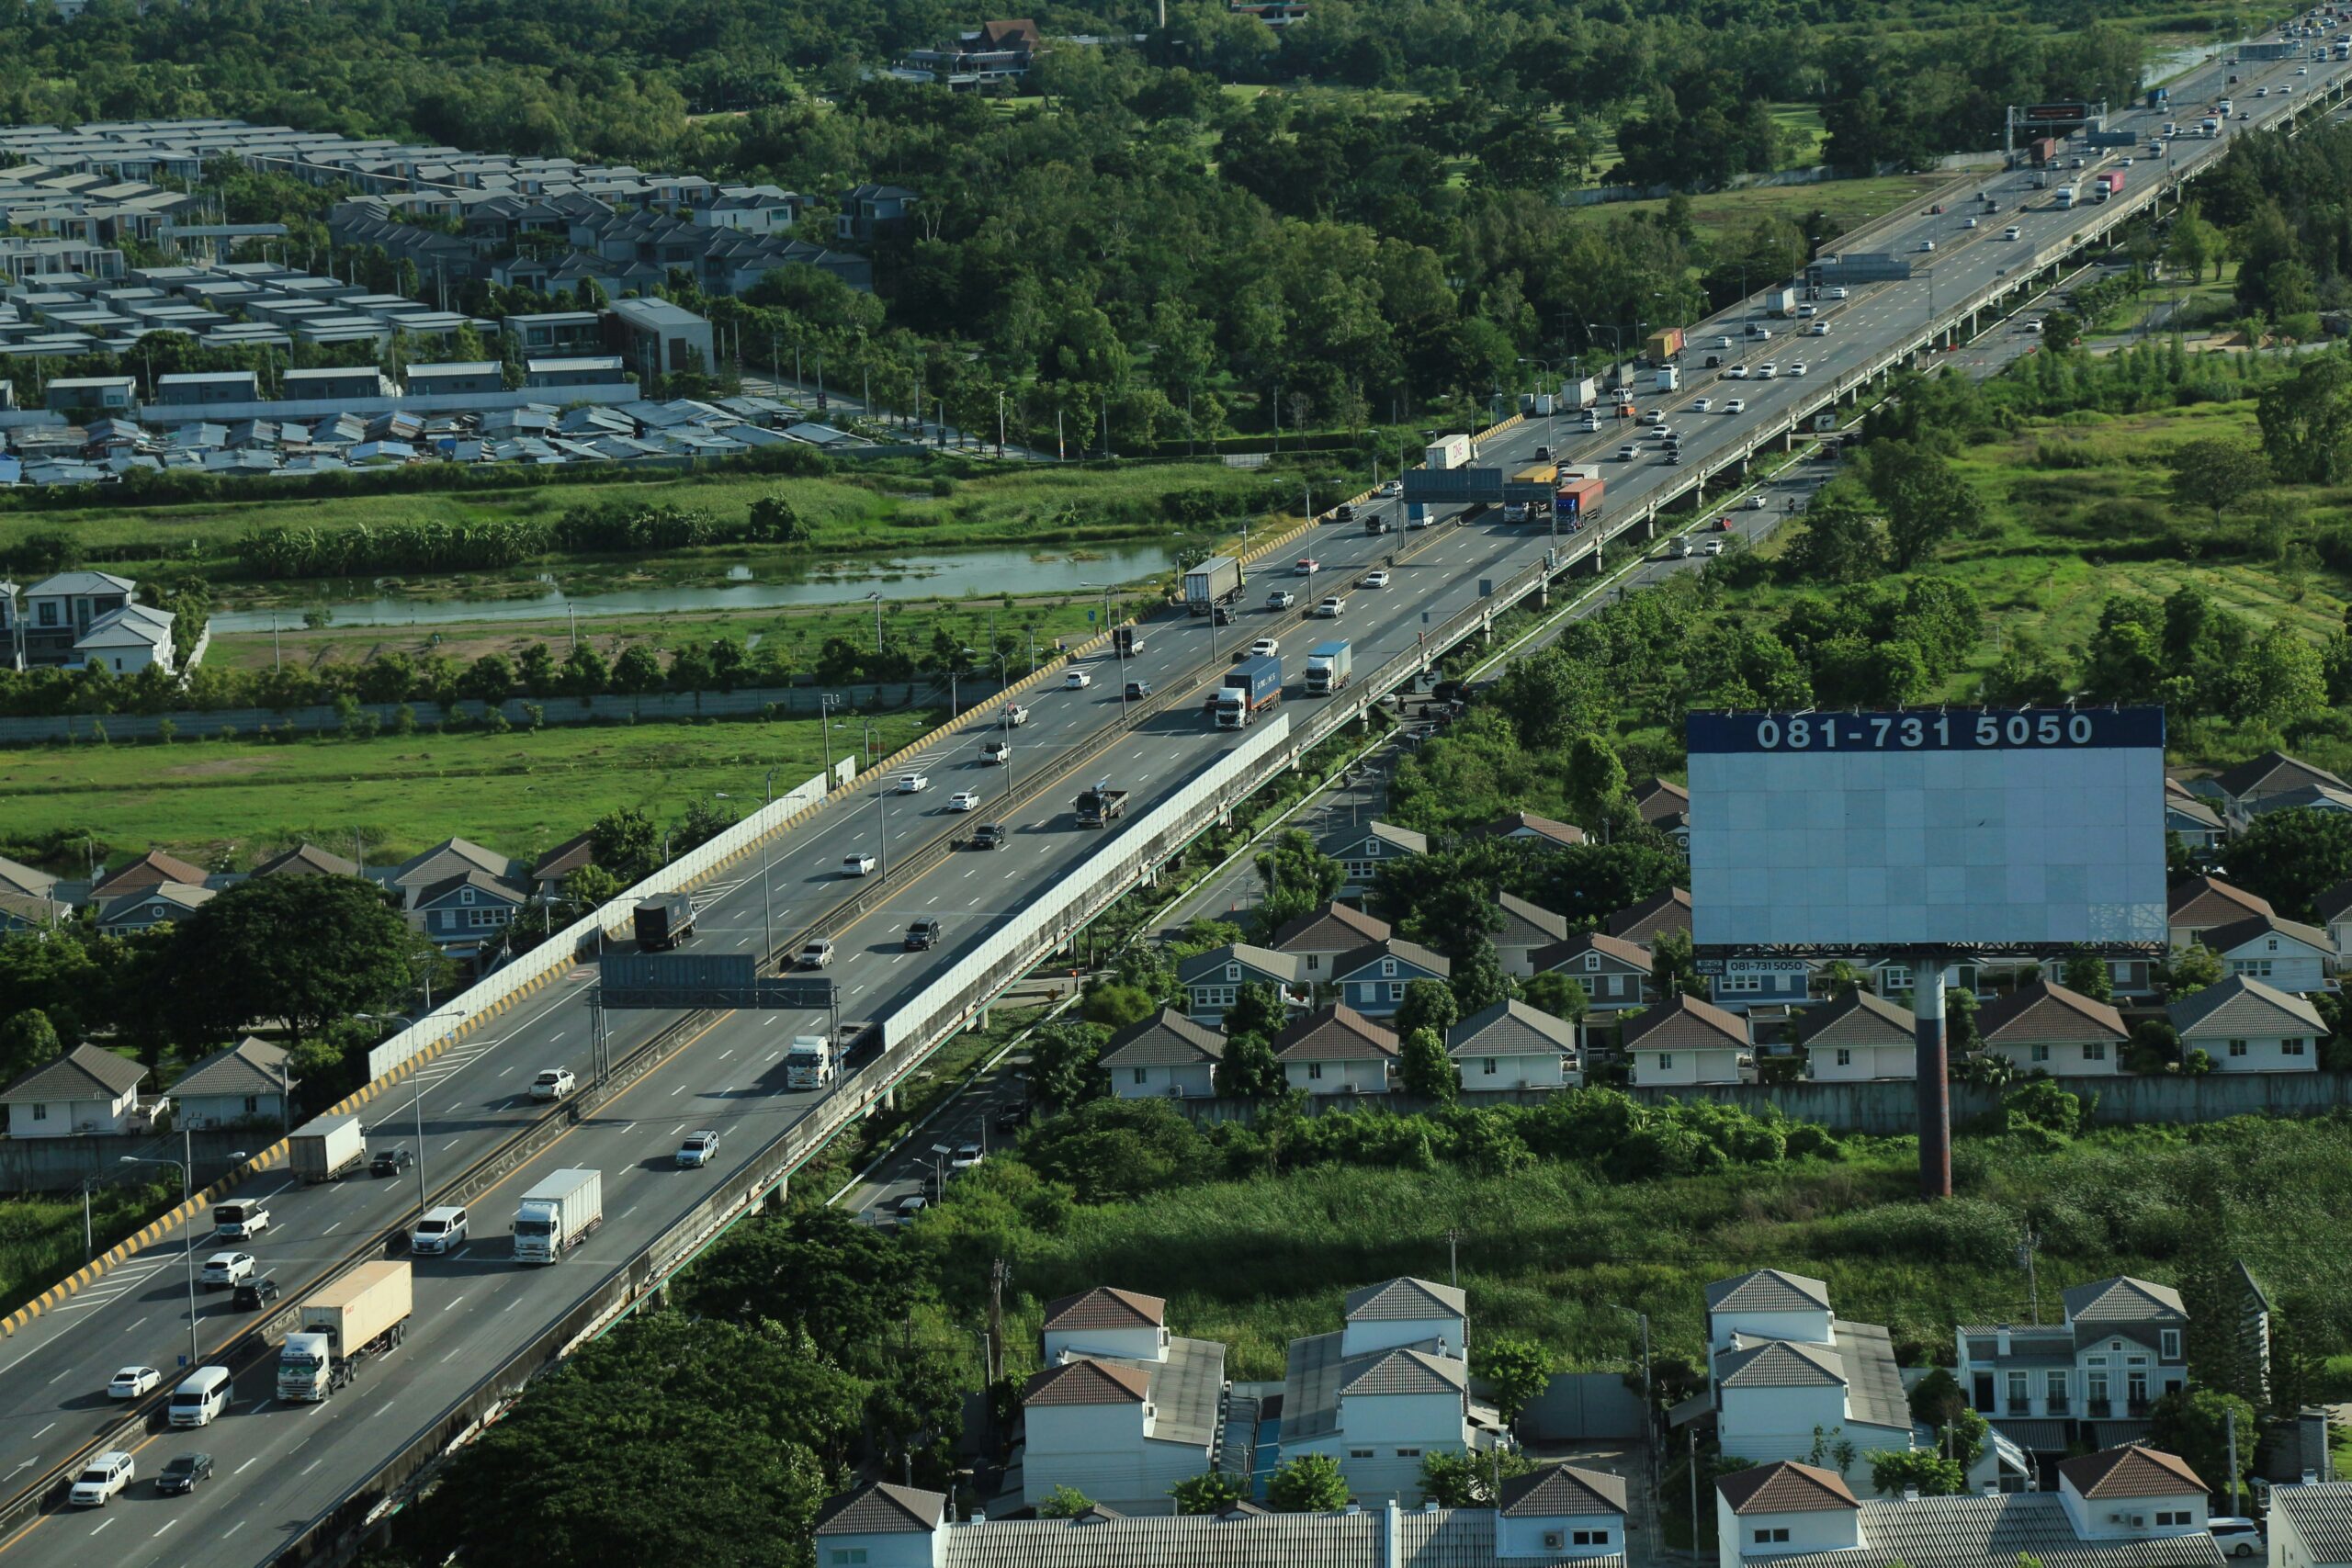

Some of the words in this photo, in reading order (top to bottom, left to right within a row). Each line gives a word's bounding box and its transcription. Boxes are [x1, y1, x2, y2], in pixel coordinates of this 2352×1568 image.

[1757, 717, 1949, 749] 081-731
[1975, 715, 2092, 746] 5050
[1730, 962, 1772, 971] 081-731
[1773, 962, 1803, 971] 5050
